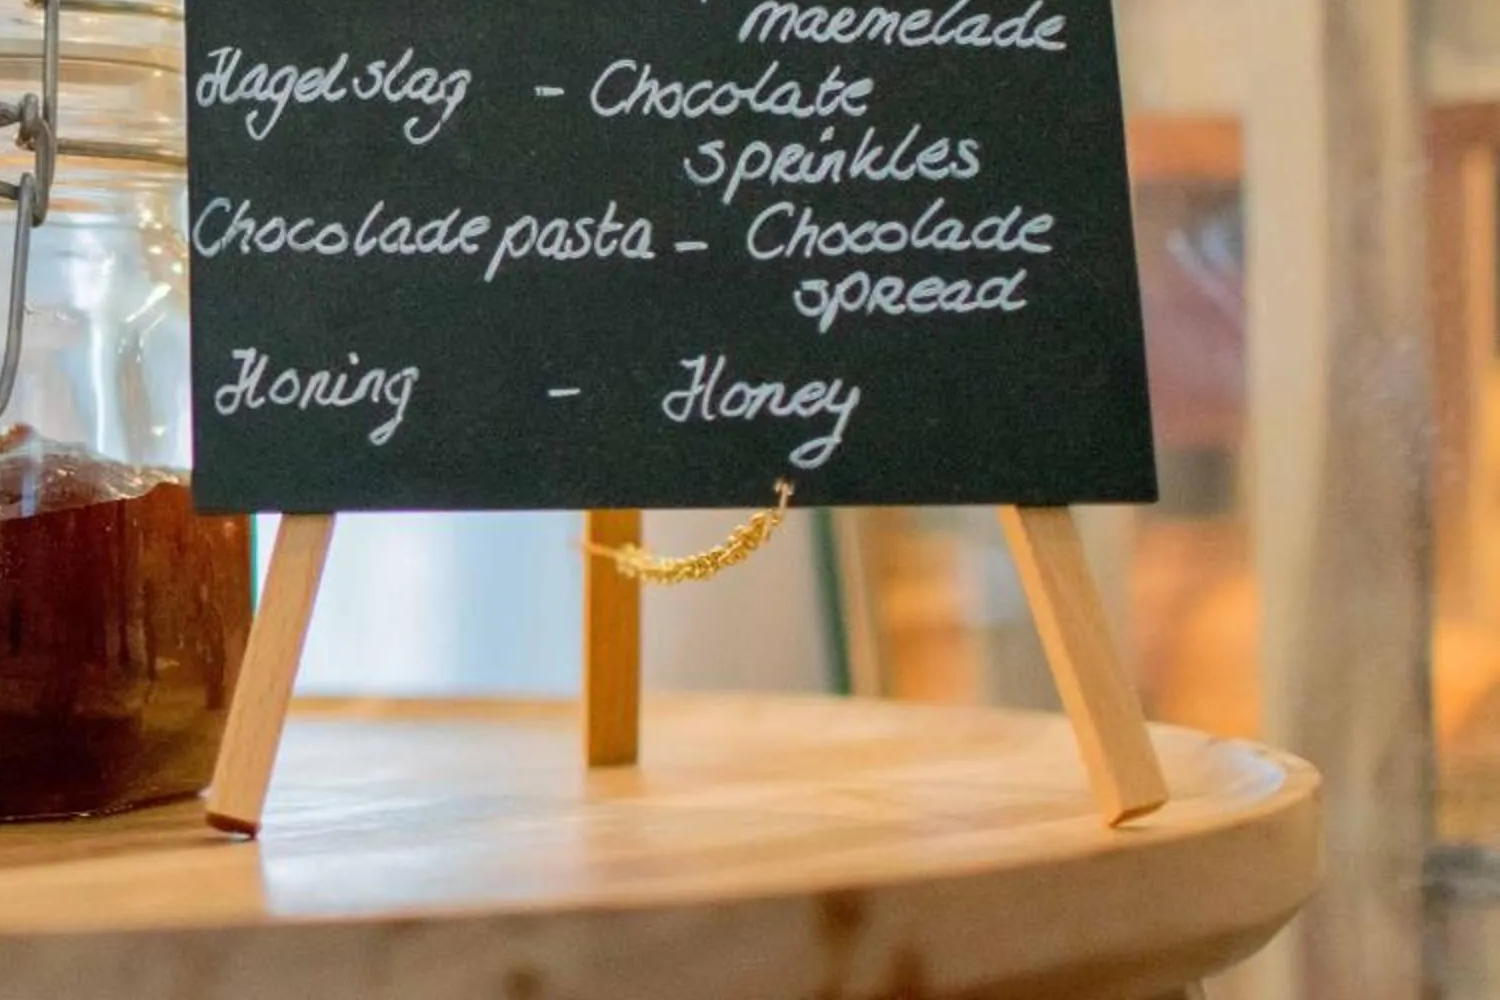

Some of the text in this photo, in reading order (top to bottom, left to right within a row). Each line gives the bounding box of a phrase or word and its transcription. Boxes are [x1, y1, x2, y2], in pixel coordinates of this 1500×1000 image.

[590, 58, 875, 119] Chocolate
[746, 197, 1055, 260] Chocolade
[215, 347, 420, 446] Honing
[662, 354, 861, 469] Honey
